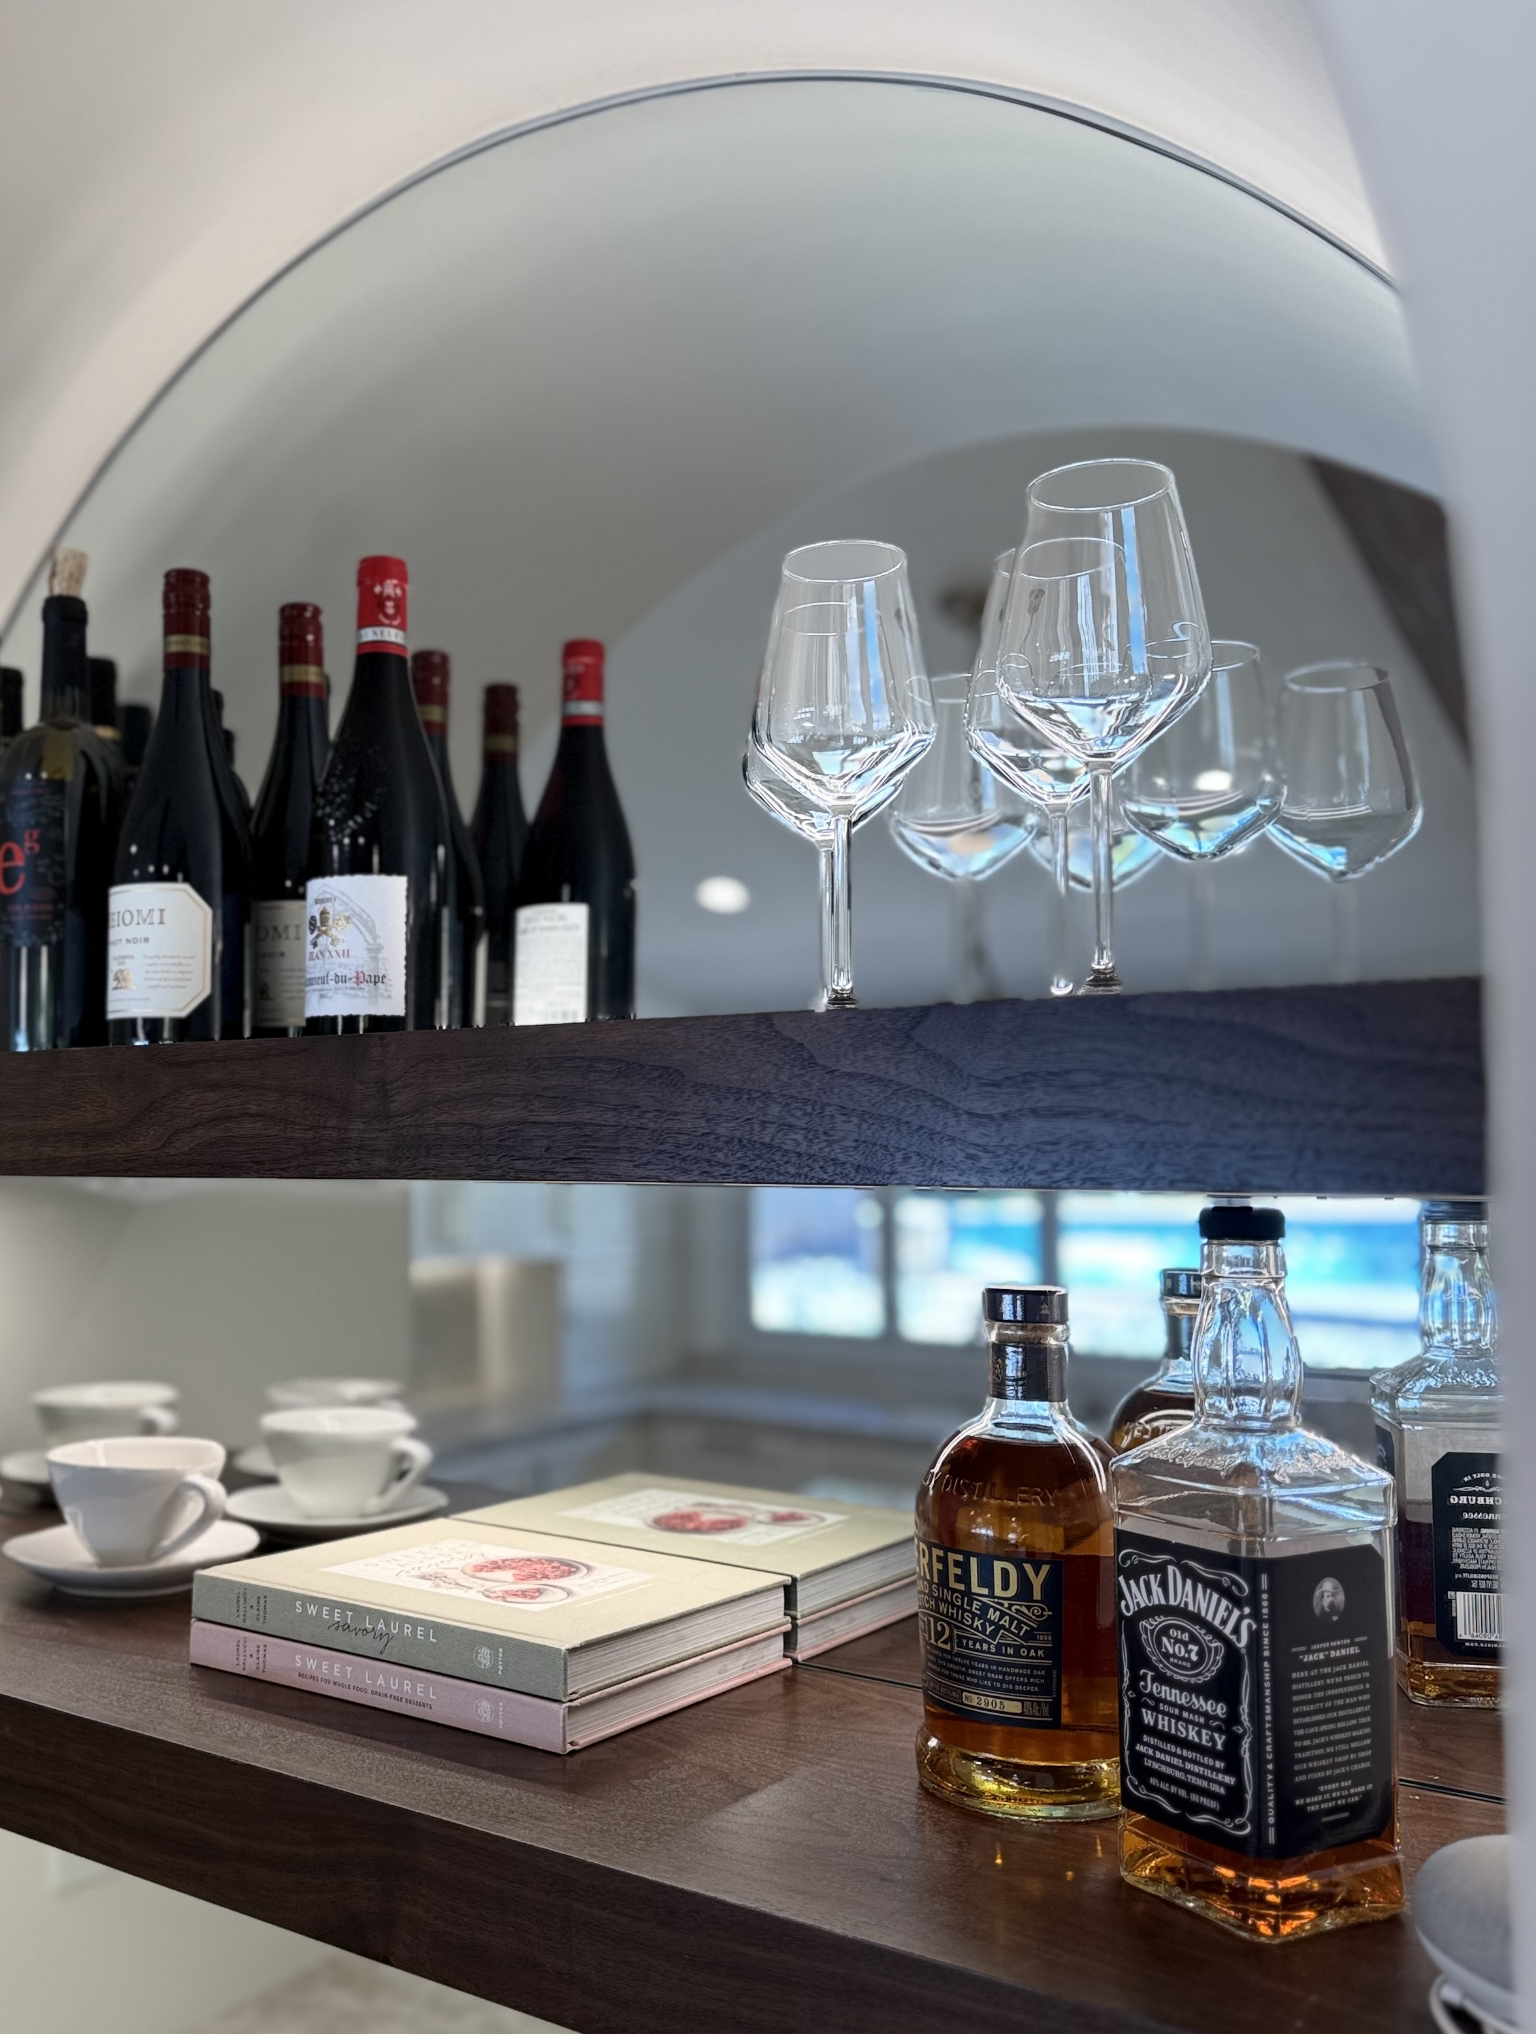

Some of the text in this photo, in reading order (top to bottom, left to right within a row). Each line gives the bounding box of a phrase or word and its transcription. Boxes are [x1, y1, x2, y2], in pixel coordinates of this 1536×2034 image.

[942, 1474, 1058, 1507] DISTILLERY
[932, 1585, 982, 1614] SINGLE
[987, 1608, 1030, 1637] MALT
[1118, 1565, 1257, 1648] JACK DANIEL'S
[295, 1601, 437, 1642] SWEET LAUREL
[939, 1601, 996, 1636] WHISKY
[328, 1620, 395, 1655] savory
[927, 1617, 950, 1650] 12
[1169, 1628, 1189, 1641] Old
[962, 1639, 1044, 1658] YEARS IN OAK
[1330, 1646, 1360, 1657] DANIEL
[968, 1668, 986, 1676] SWEET
[998, 1666, 1031, 1674] HANDMADE
[1170, 1658, 1191, 1668] BRAND
[1333, 1664, 1346, 1673] JACK
[1349, 1660, 1369, 1669] DANIEL
[295, 1655, 437, 1699] SWEET LAUREL
[1344, 1673, 1361, 1681] PROUD
[298, 1672, 319, 1682] RECIPES
[320, 1677, 331, 1685] FOR
[332, 1679, 351, 1690] WHOLE
[371, 1690, 403, 1702] GRAIN-FREE
[405, 1697, 433, 1710] DESSERTS
[1139, 1669, 1227, 1718] Tennessee
[1292, 1693, 1312, 1701] HONOR
[1326, 1684, 1364, 1696] INDEPENDENCE
[976, 1696, 1006, 1710] 2905
[1264, 1661, 1272, 1759] CRAFTSMANSHIP
[1292, 1703, 1323, 1713] INTEGRITY
[1159, 1702, 1205, 1724] SOUR MASH
[1293, 1714, 1326, 1724] ESTABLISHED
[1141, 1708, 1227, 1750] WHISKEY
[1319, 1723, 1336, 1731] SPRING
[1312, 1736, 1329, 1746] JACK'S
[1330, 1732, 1352, 1740] WHISKEY
[1352, 1728, 1371, 1736] MAKING
[1350, 1739, 1371, 1748] MELLOW
[1143, 1734, 1176, 1753] DISTILLED
[1182, 1749, 1213, 1767] BOTTLED
[1215, 1760, 1225, 1769] BY
[1136, 1743, 1236, 1785] JACK DANIEL DISTILLERY
[1308, 1758, 1333, 1767] WHISKEY
[1308, 1771, 1325, 1780] STAND
[1333, 1766, 1349, 1776] JACK'S
[1170, 1784, 1178, 1794] BY
[1200, 1796, 1220, 1811] PROOF)
[1306, 1795, 1322, 1803] MAKE
[1321, 1801, 1336, 1809] BEST
